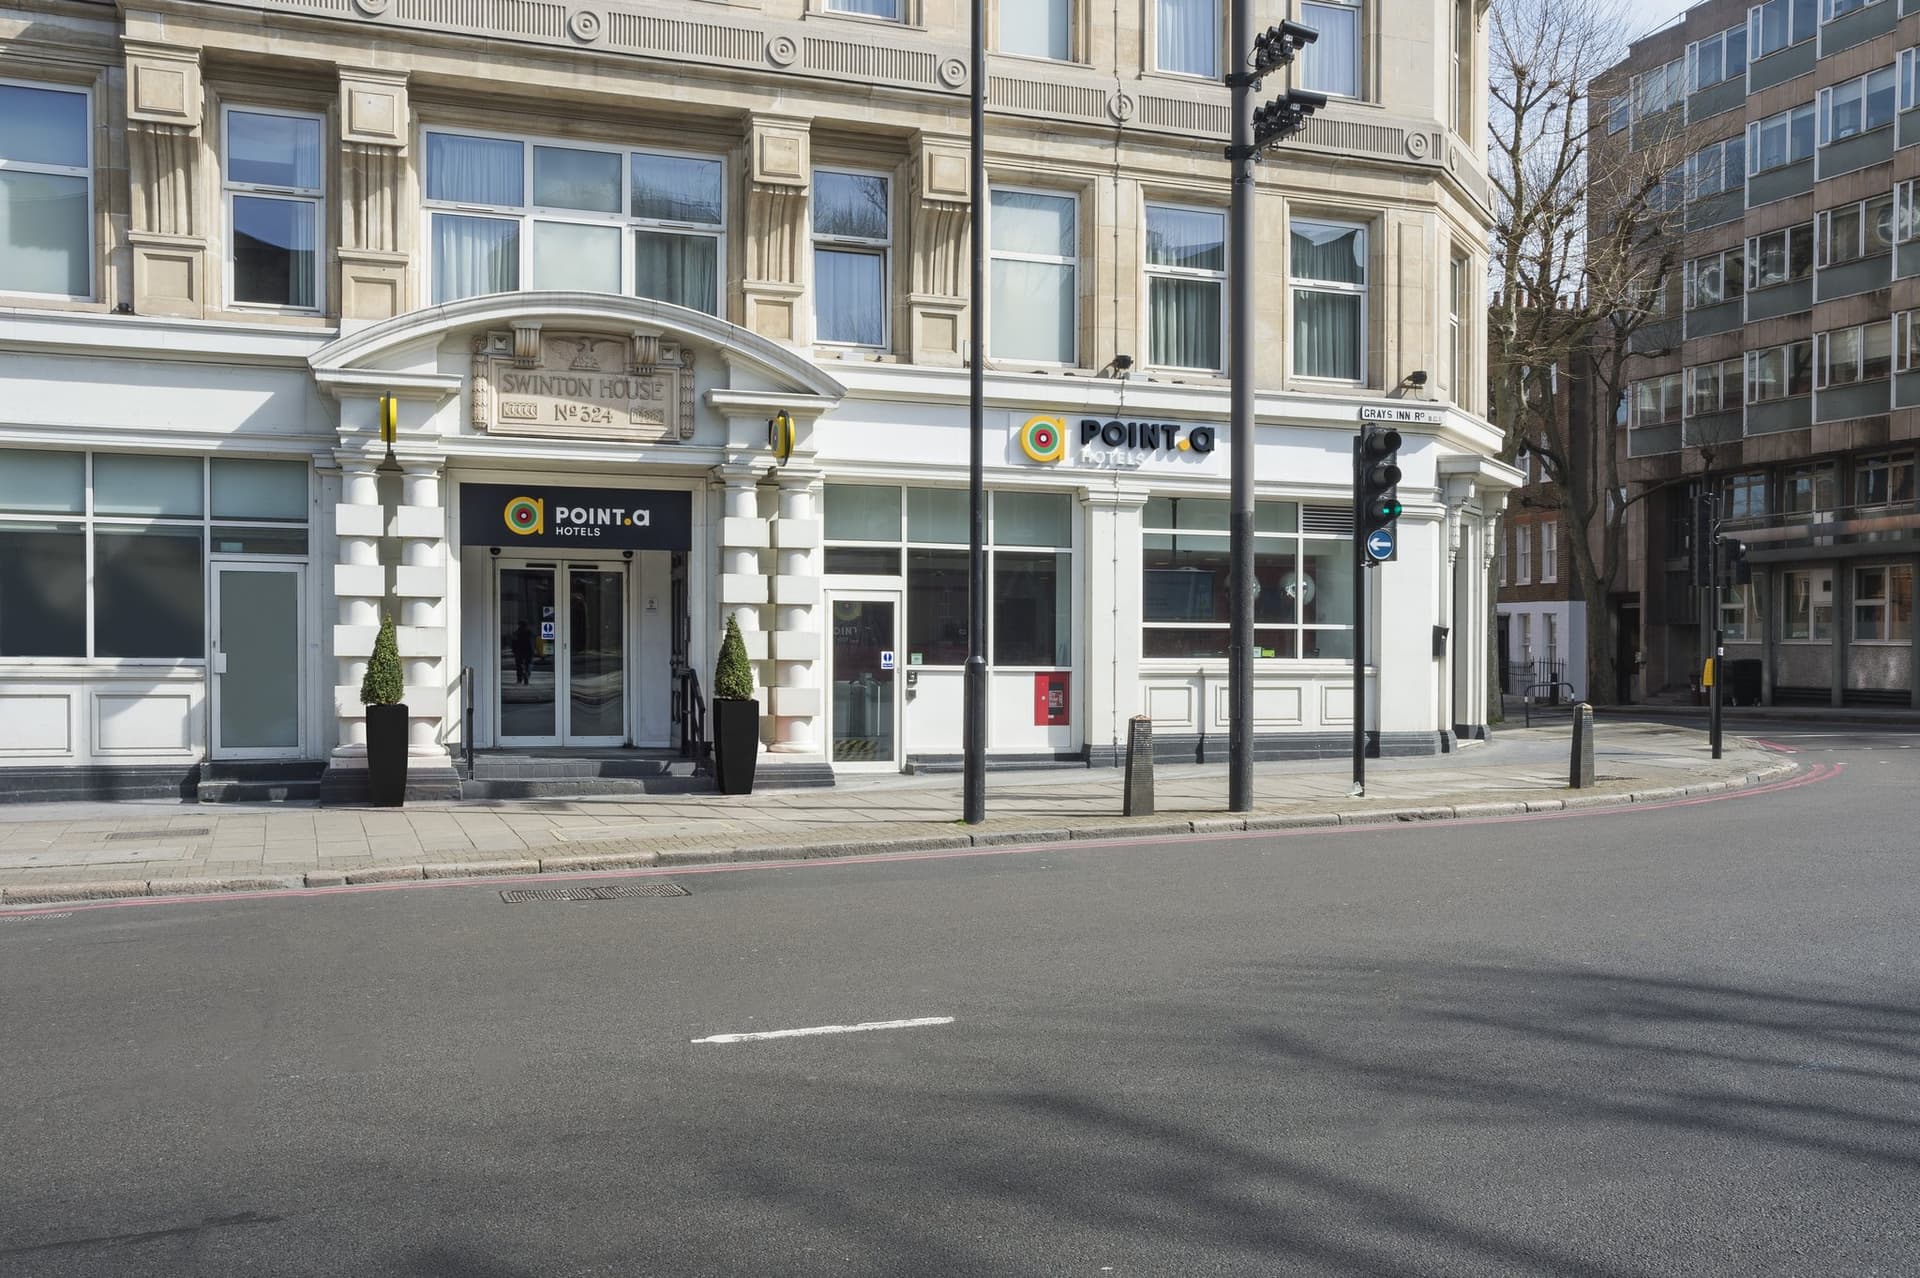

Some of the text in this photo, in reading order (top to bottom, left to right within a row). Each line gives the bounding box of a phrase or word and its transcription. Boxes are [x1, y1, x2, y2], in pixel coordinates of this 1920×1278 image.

[503, 374, 664, 400] SWINTON HOUSE
[580, 405, 613, 424] 324
[1364, 409, 1392, 419] GRAYS
[1396, 411, 1411, 420] INN
[1082, 448, 1145, 465] HOTELS
[555, 527, 601, 536] HOTELS
